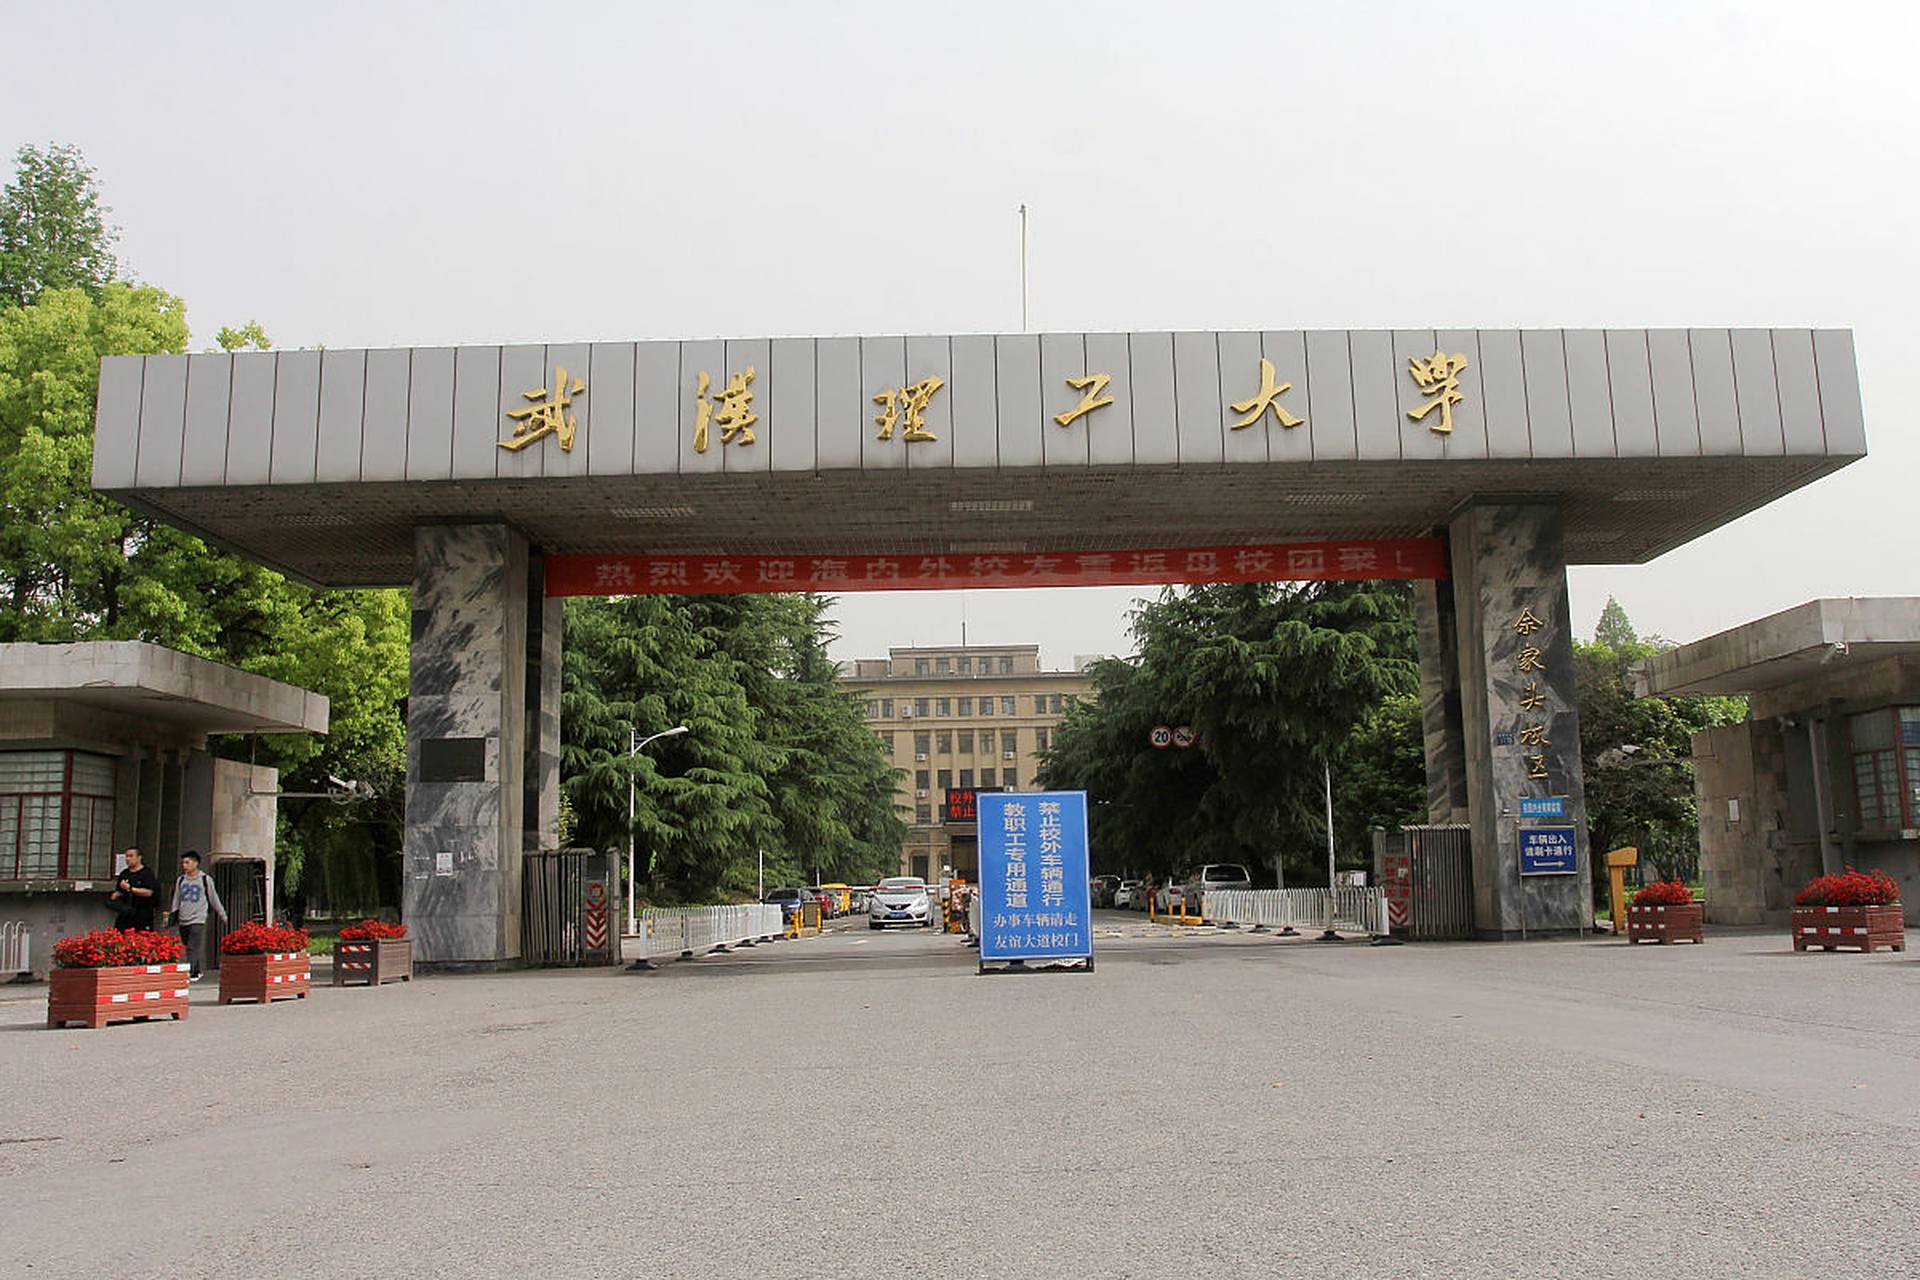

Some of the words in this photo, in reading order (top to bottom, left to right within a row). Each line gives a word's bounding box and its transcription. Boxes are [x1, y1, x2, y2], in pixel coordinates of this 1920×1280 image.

[1155, 731, 1169, 743] 20
[1003, 802, 1028, 908] 教职工专用通道
[1039, 801, 1065, 907] 禁止校外车辆通行
[994, 933, 1079, 948] 友谊大道校门
